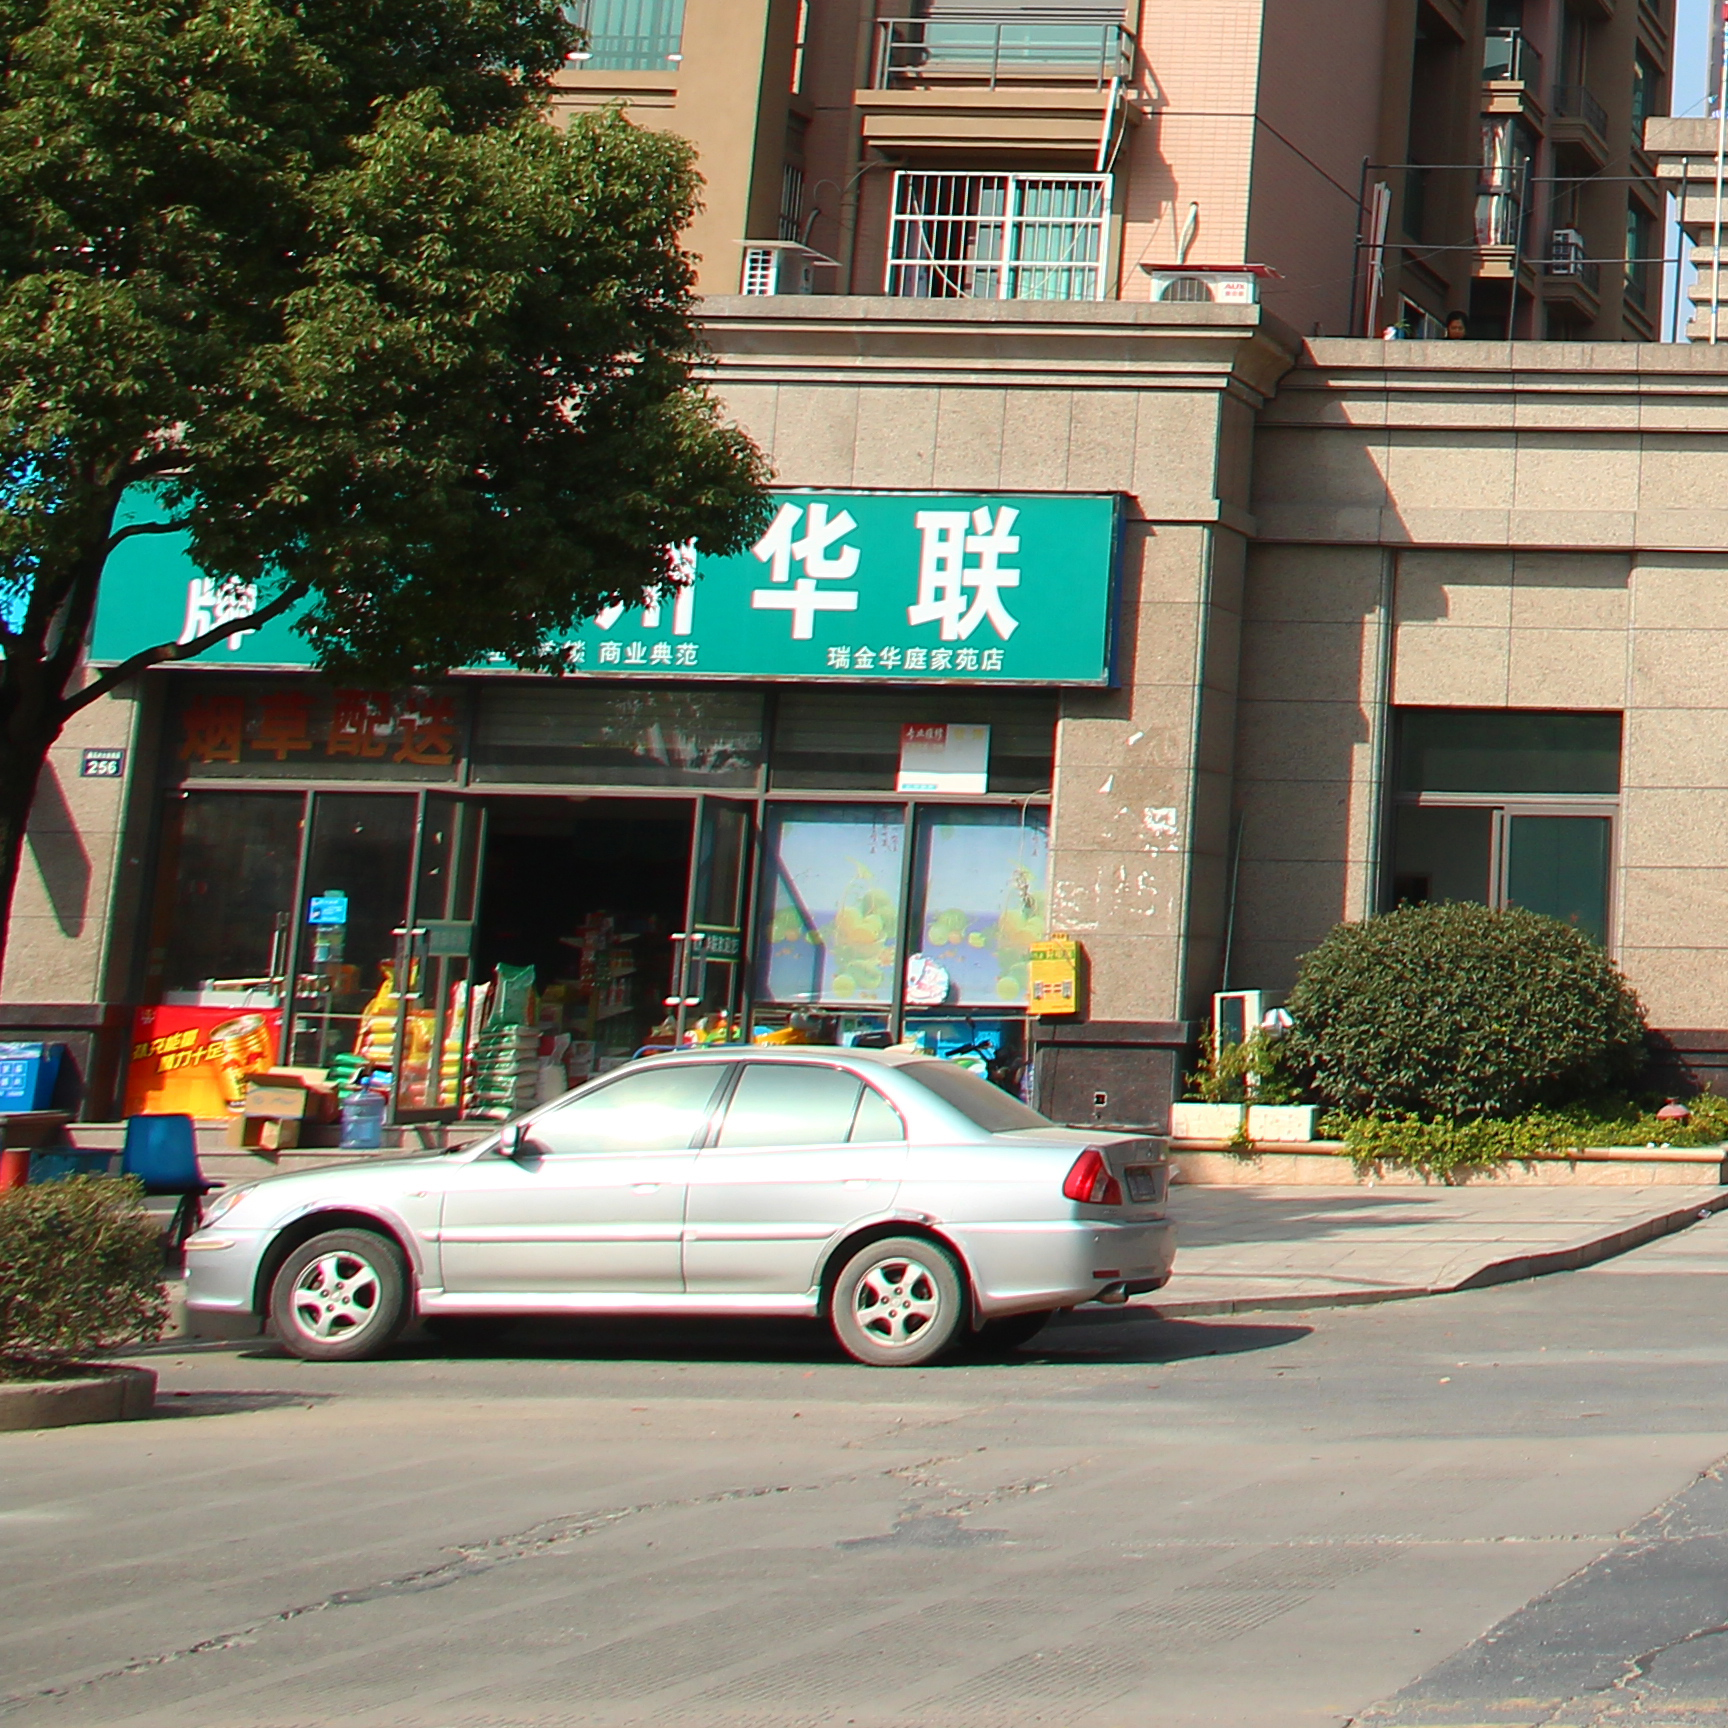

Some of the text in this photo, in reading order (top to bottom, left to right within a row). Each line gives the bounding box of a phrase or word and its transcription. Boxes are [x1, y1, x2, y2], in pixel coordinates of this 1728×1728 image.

[599, 640, 700, 666] 商业典范
[826, 646, 1007, 673] 瑞金华庭家苑店
[178, 688, 459, 766] 烟草配送
[86, 760, 118, 774] 256
